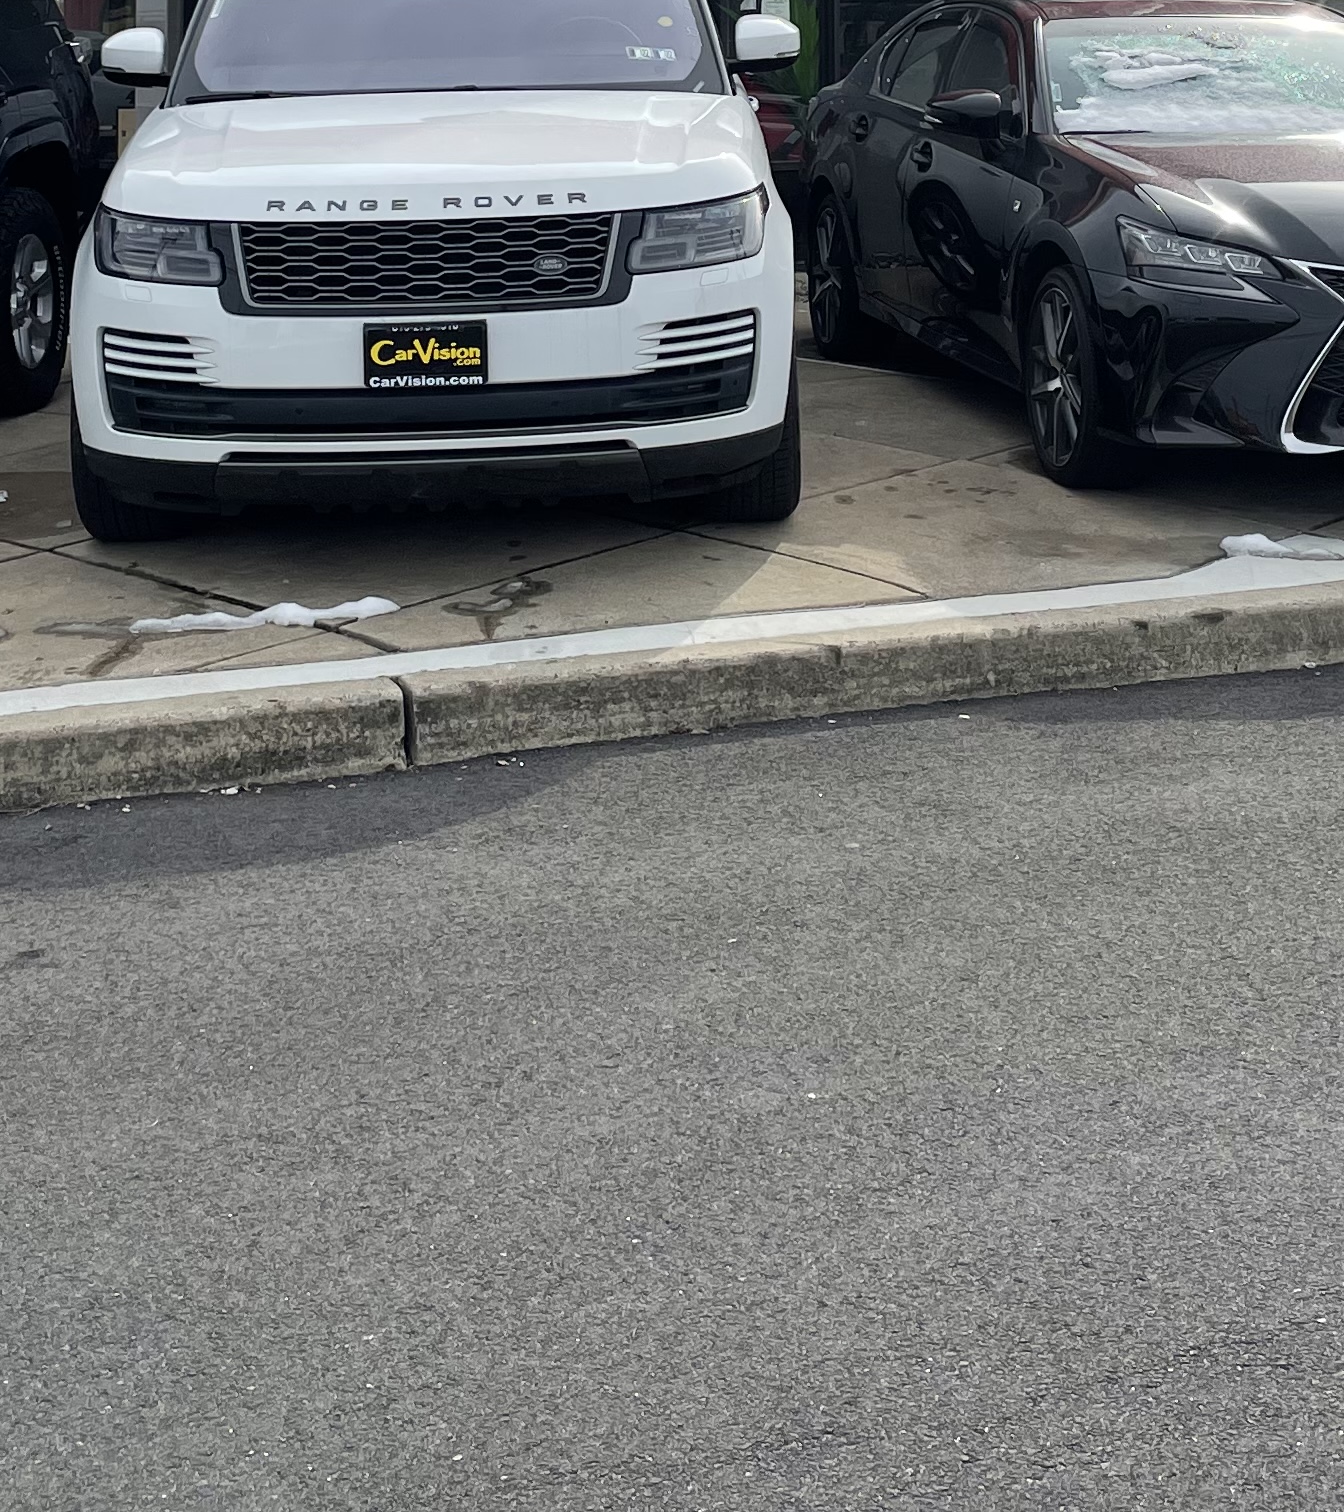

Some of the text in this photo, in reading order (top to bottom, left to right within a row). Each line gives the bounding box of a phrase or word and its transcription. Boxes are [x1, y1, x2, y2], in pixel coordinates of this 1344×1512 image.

[266, 192, 588, 212] RANGE ROVER
[370, 338, 481, 366] CarVision
[369, 375, 483, 388] CarVision.com
